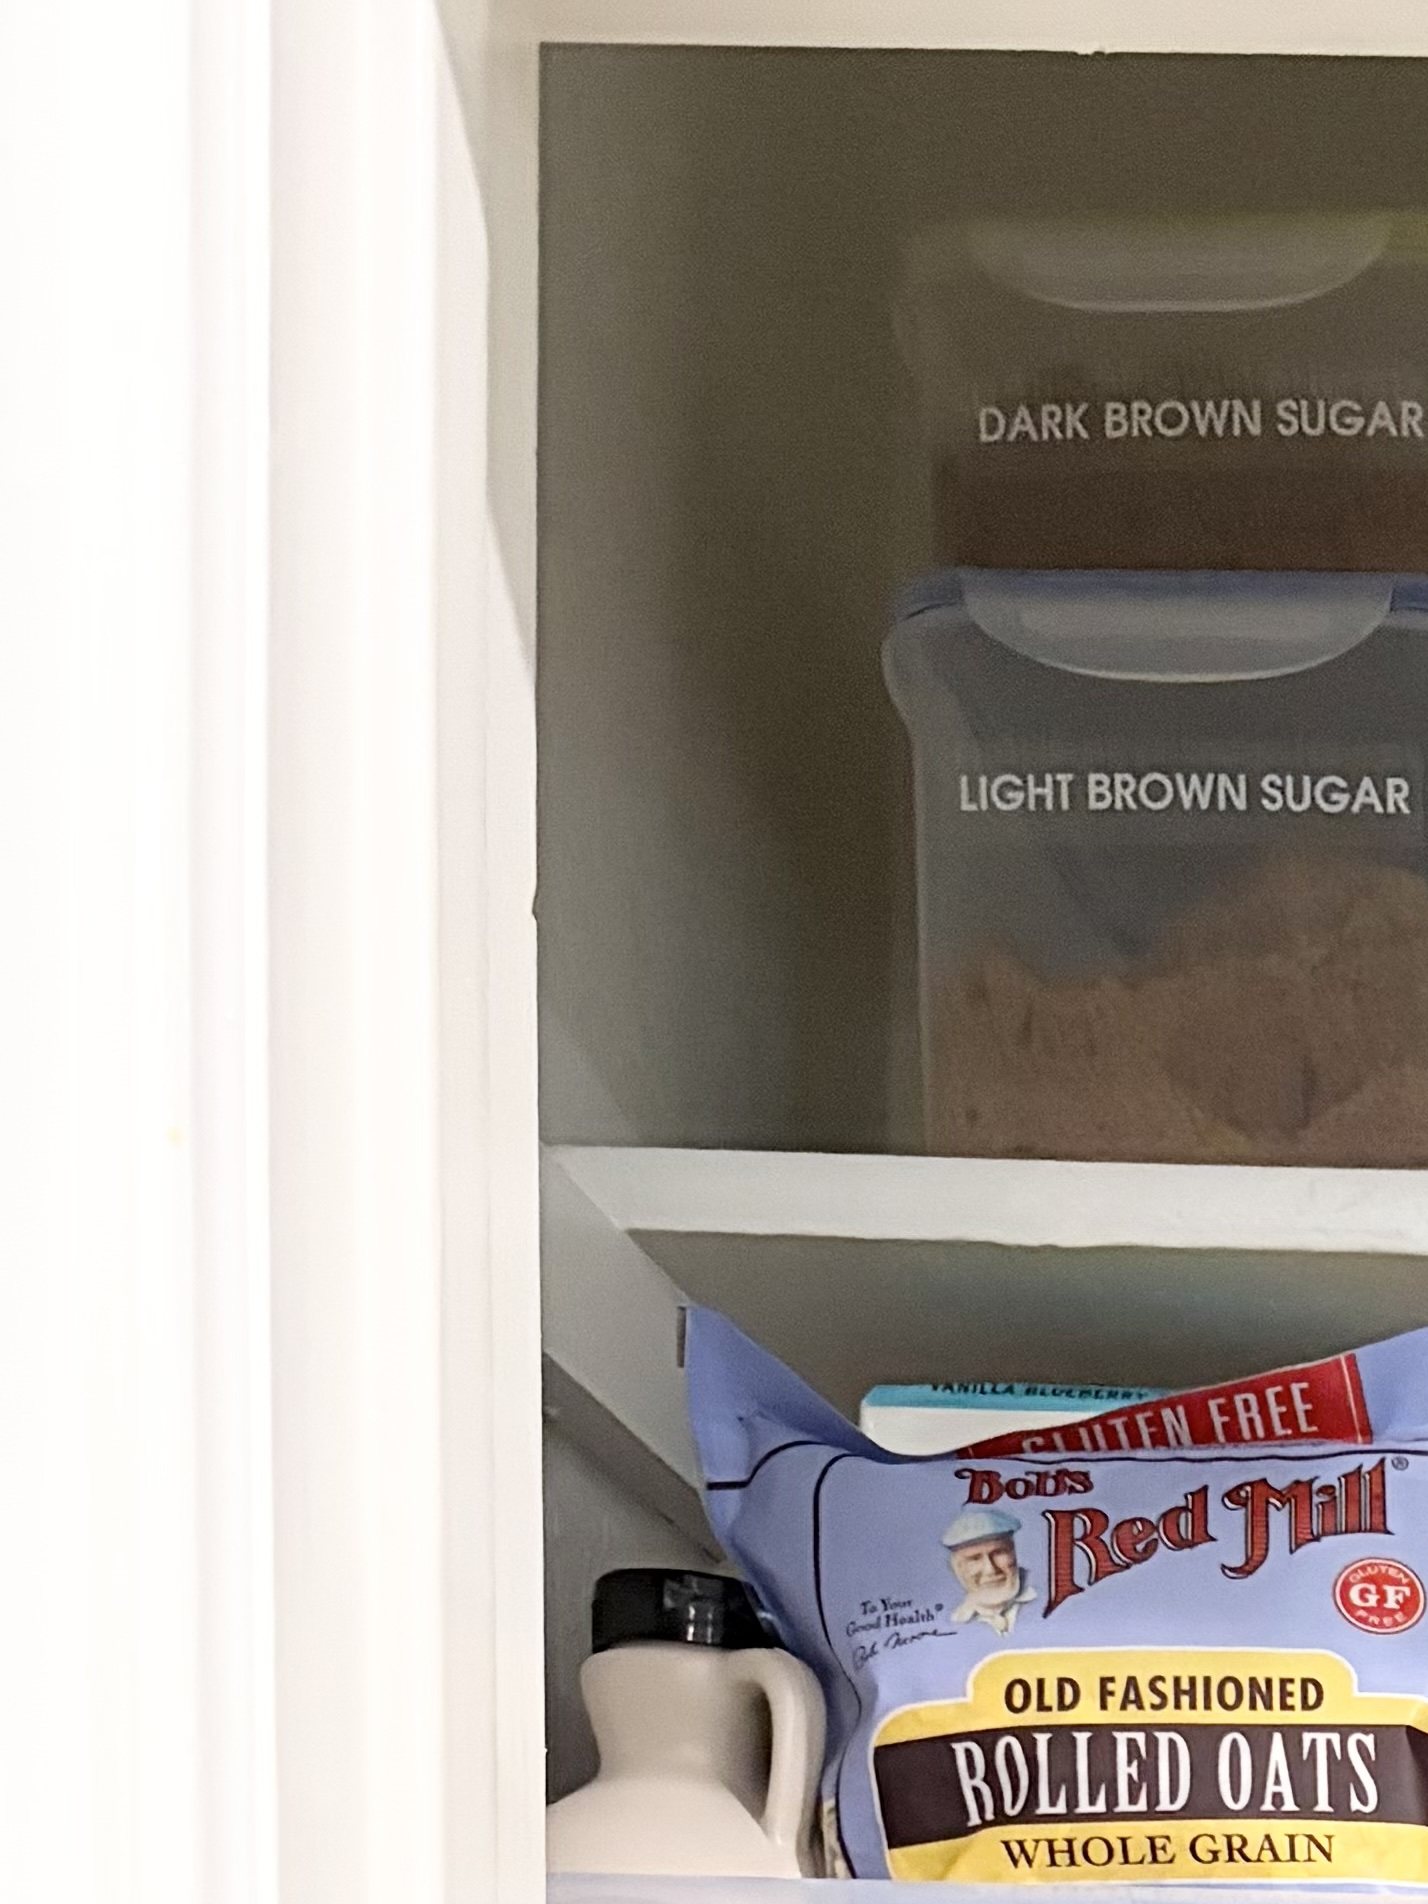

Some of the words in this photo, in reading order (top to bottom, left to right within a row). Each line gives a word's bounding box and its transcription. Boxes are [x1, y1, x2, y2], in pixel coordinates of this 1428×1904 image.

[978, 403, 1091, 442] DARK
[1103, 399, 1261, 438] BROWN
[1274, 397, 1424, 439] SUGAR
[959, 774, 1074, 812] LIGHT
[1087, 773, 1246, 811] BROWN
[1260, 774, 1411, 814] SUGAR
[1209, 1382, 1318, 1442] FREE
[954, 1468, 1092, 1505] Bob's
[1042, 1484, 1217, 1618] Red
[1221, 1457, 1392, 1579] Mill
[1349, 1581, 1409, 1609] GF
[885, 1609, 936, 1629] Health
[1005, 1678, 1080, 1713] OLD
[1100, 1676, 1324, 1711] FASHIONED
[952, 1732, 1191, 1827] ROLLED
[1218, 1732, 1376, 1814] OATS
[1001, 1836, 1176, 1870] WHOLE
[1189, 1833, 1334, 1864] GRAIN
